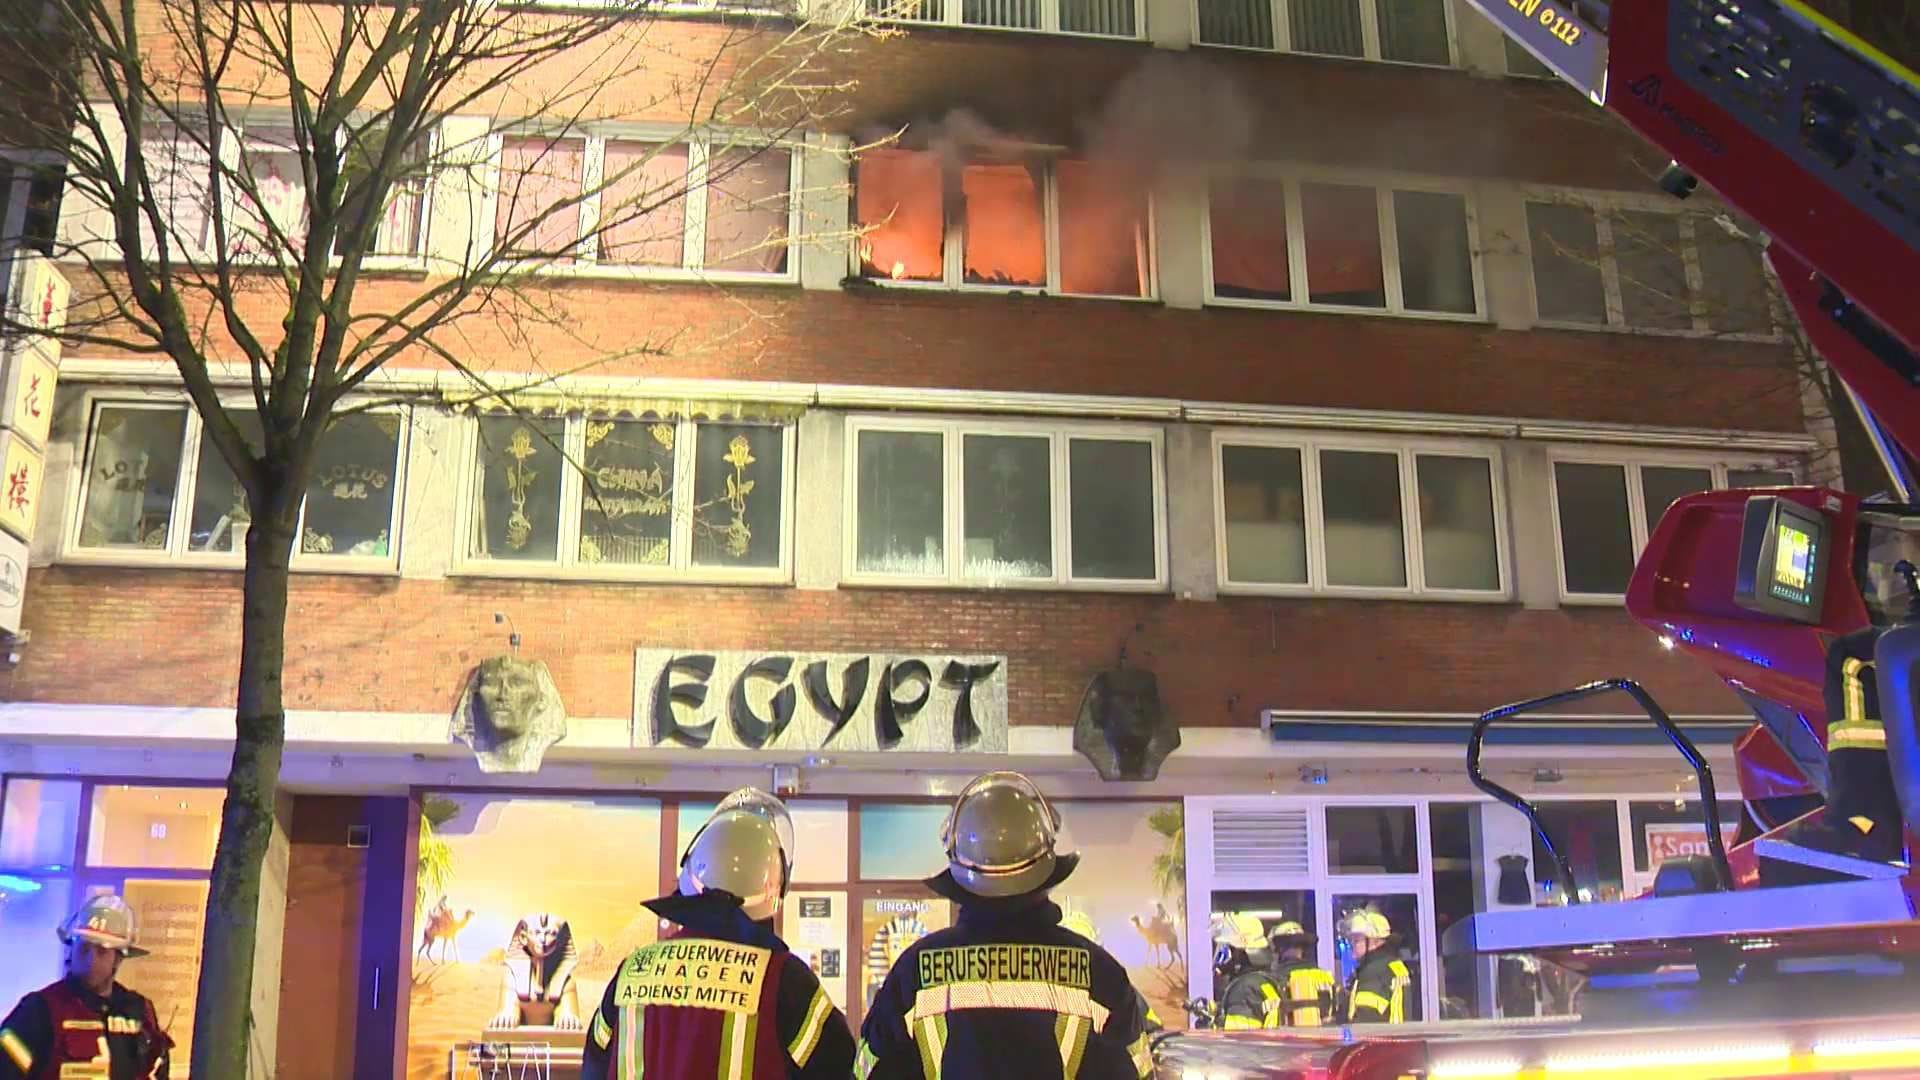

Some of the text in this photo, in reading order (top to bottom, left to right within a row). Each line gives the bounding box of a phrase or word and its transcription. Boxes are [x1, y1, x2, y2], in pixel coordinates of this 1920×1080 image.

[650, 655, 1000, 749] EGYPT
[659, 945, 758, 967] FEUERWEHR
[921, 945, 1090, 984] BERUFSFEUERWEHR
[654, 963, 755, 984] HAGEN
[622, 985, 749, 1006] A-DIENST MITTE
